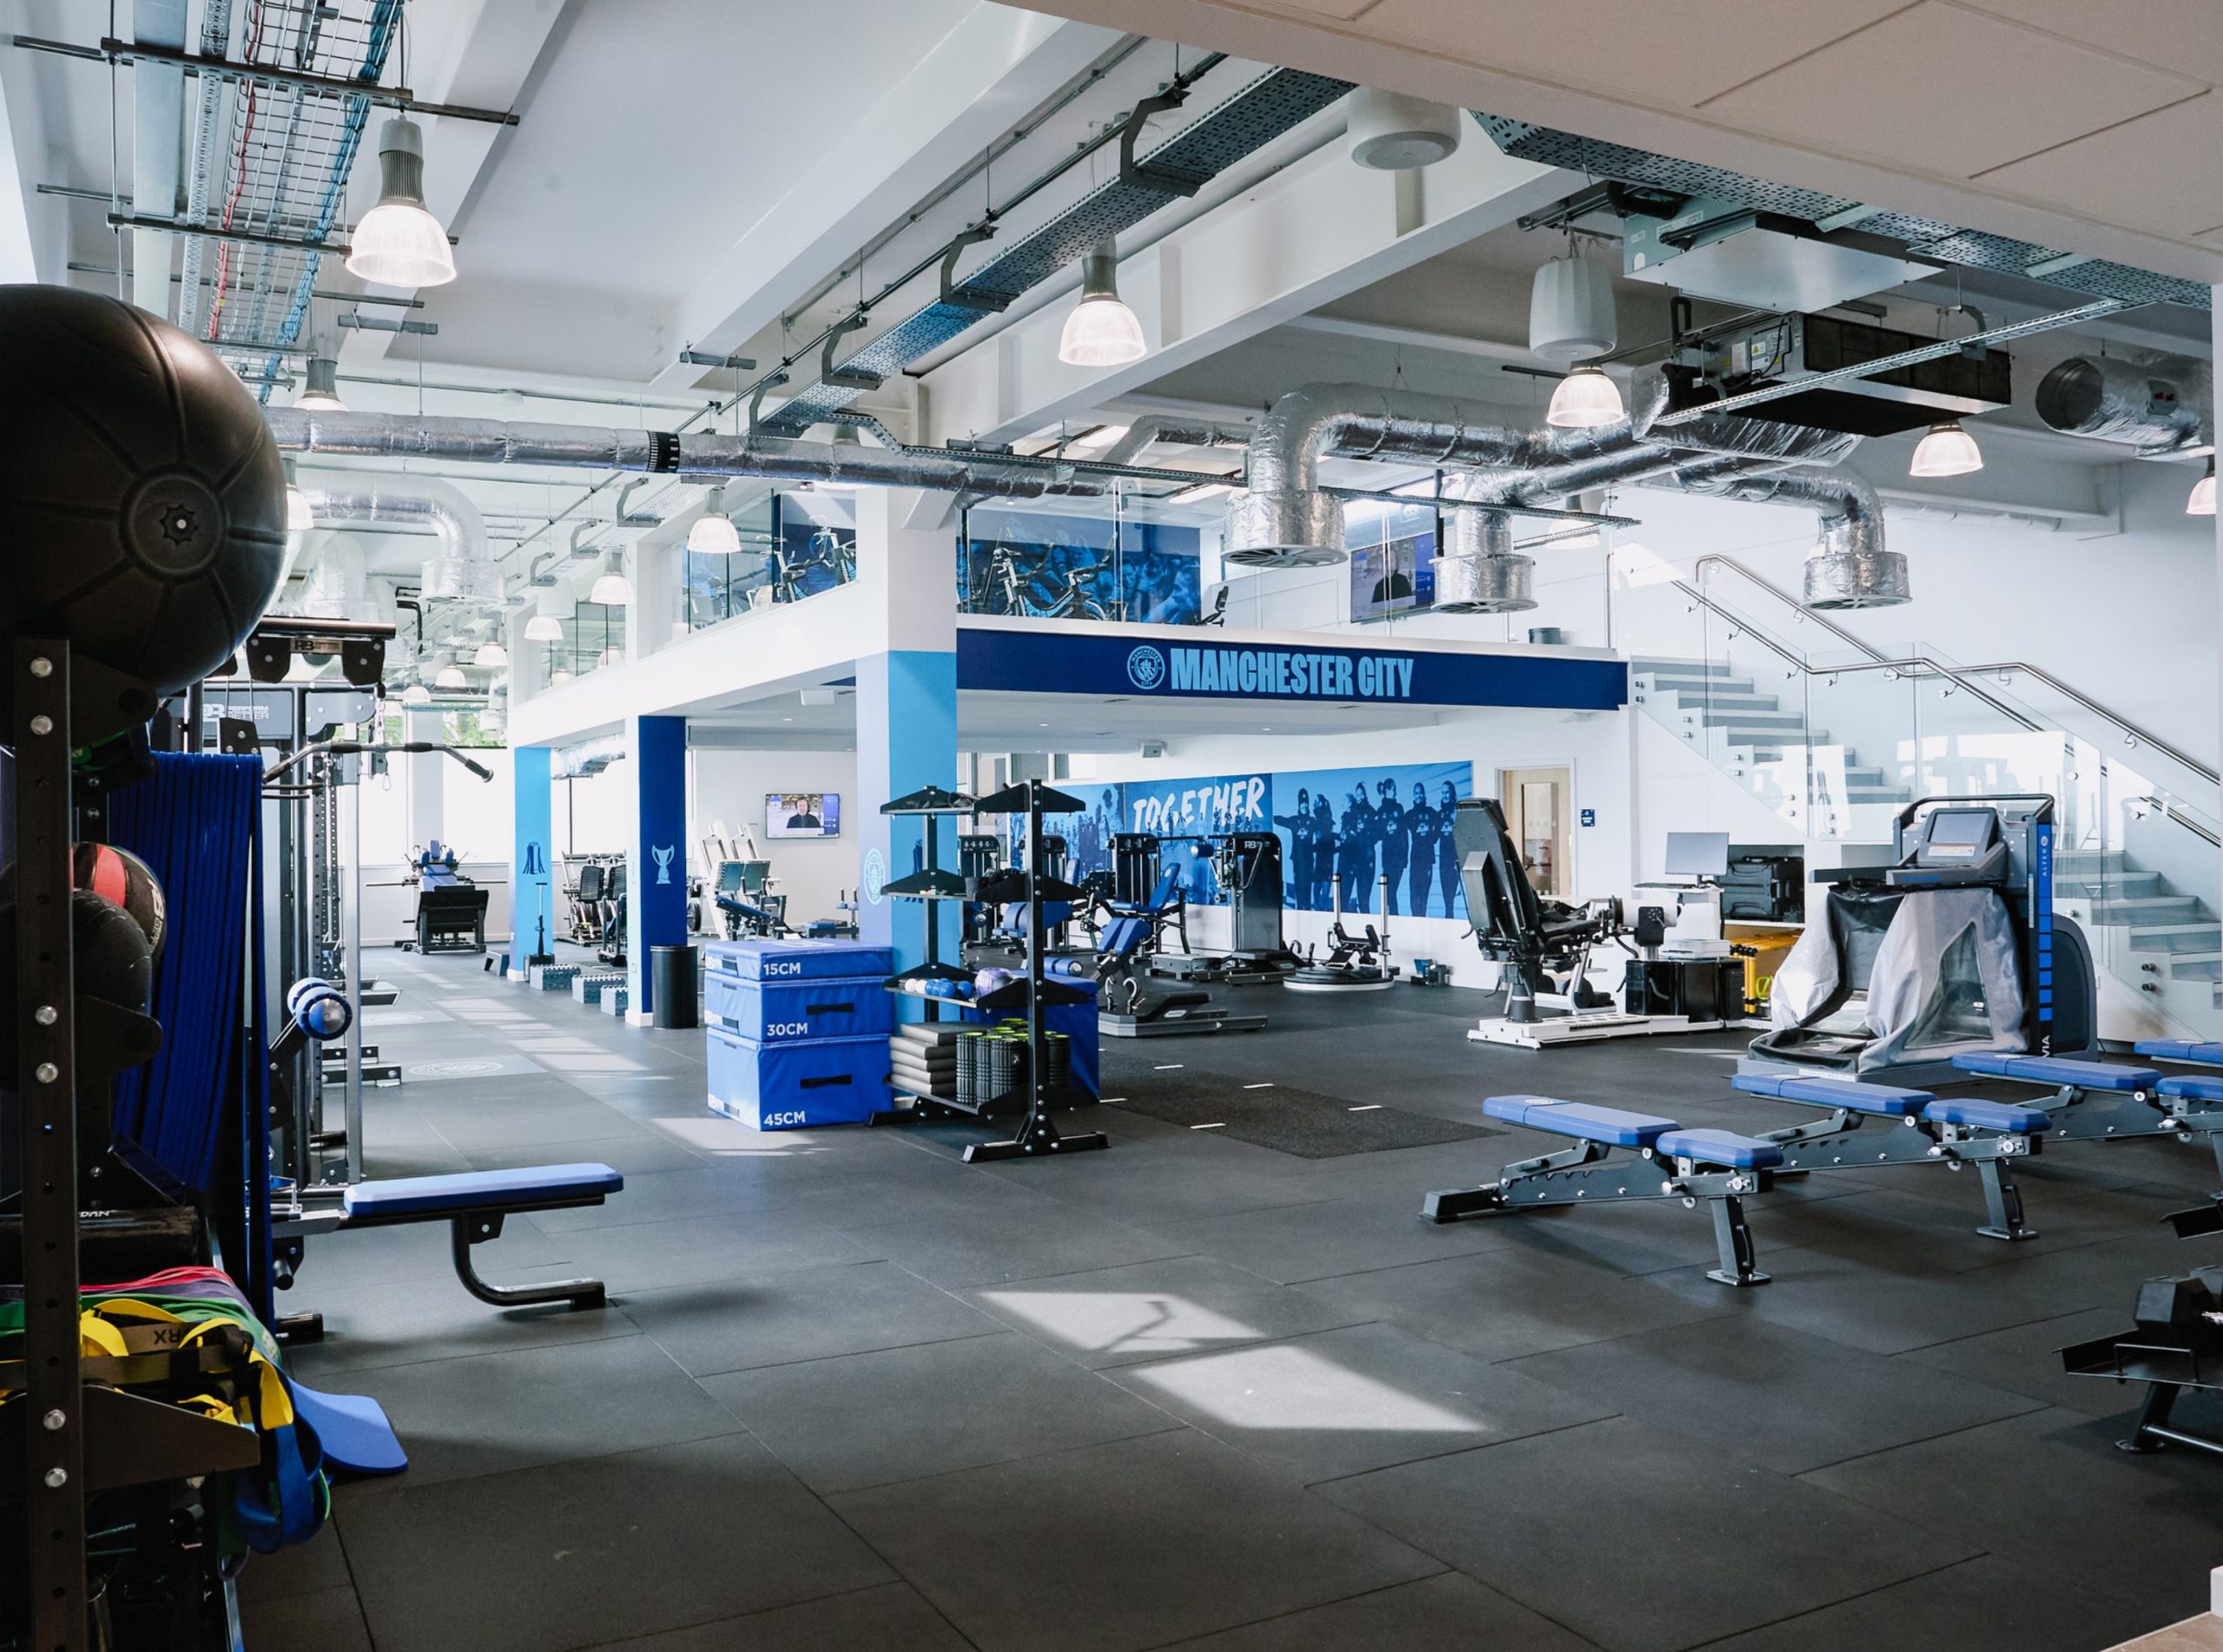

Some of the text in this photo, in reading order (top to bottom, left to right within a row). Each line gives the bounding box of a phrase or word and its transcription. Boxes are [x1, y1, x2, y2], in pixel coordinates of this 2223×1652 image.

[1171, 648, 1415, 697] MANCHESTER CITY
[1133, 777, 1265, 834] TOGETHER
[763, 962, 801, 976] 15CM
[767, 1023, 808, 1037] 30CM
[763, 1110, 806, 1126] 45CM
[154, 1328, 181, 1345] RX
